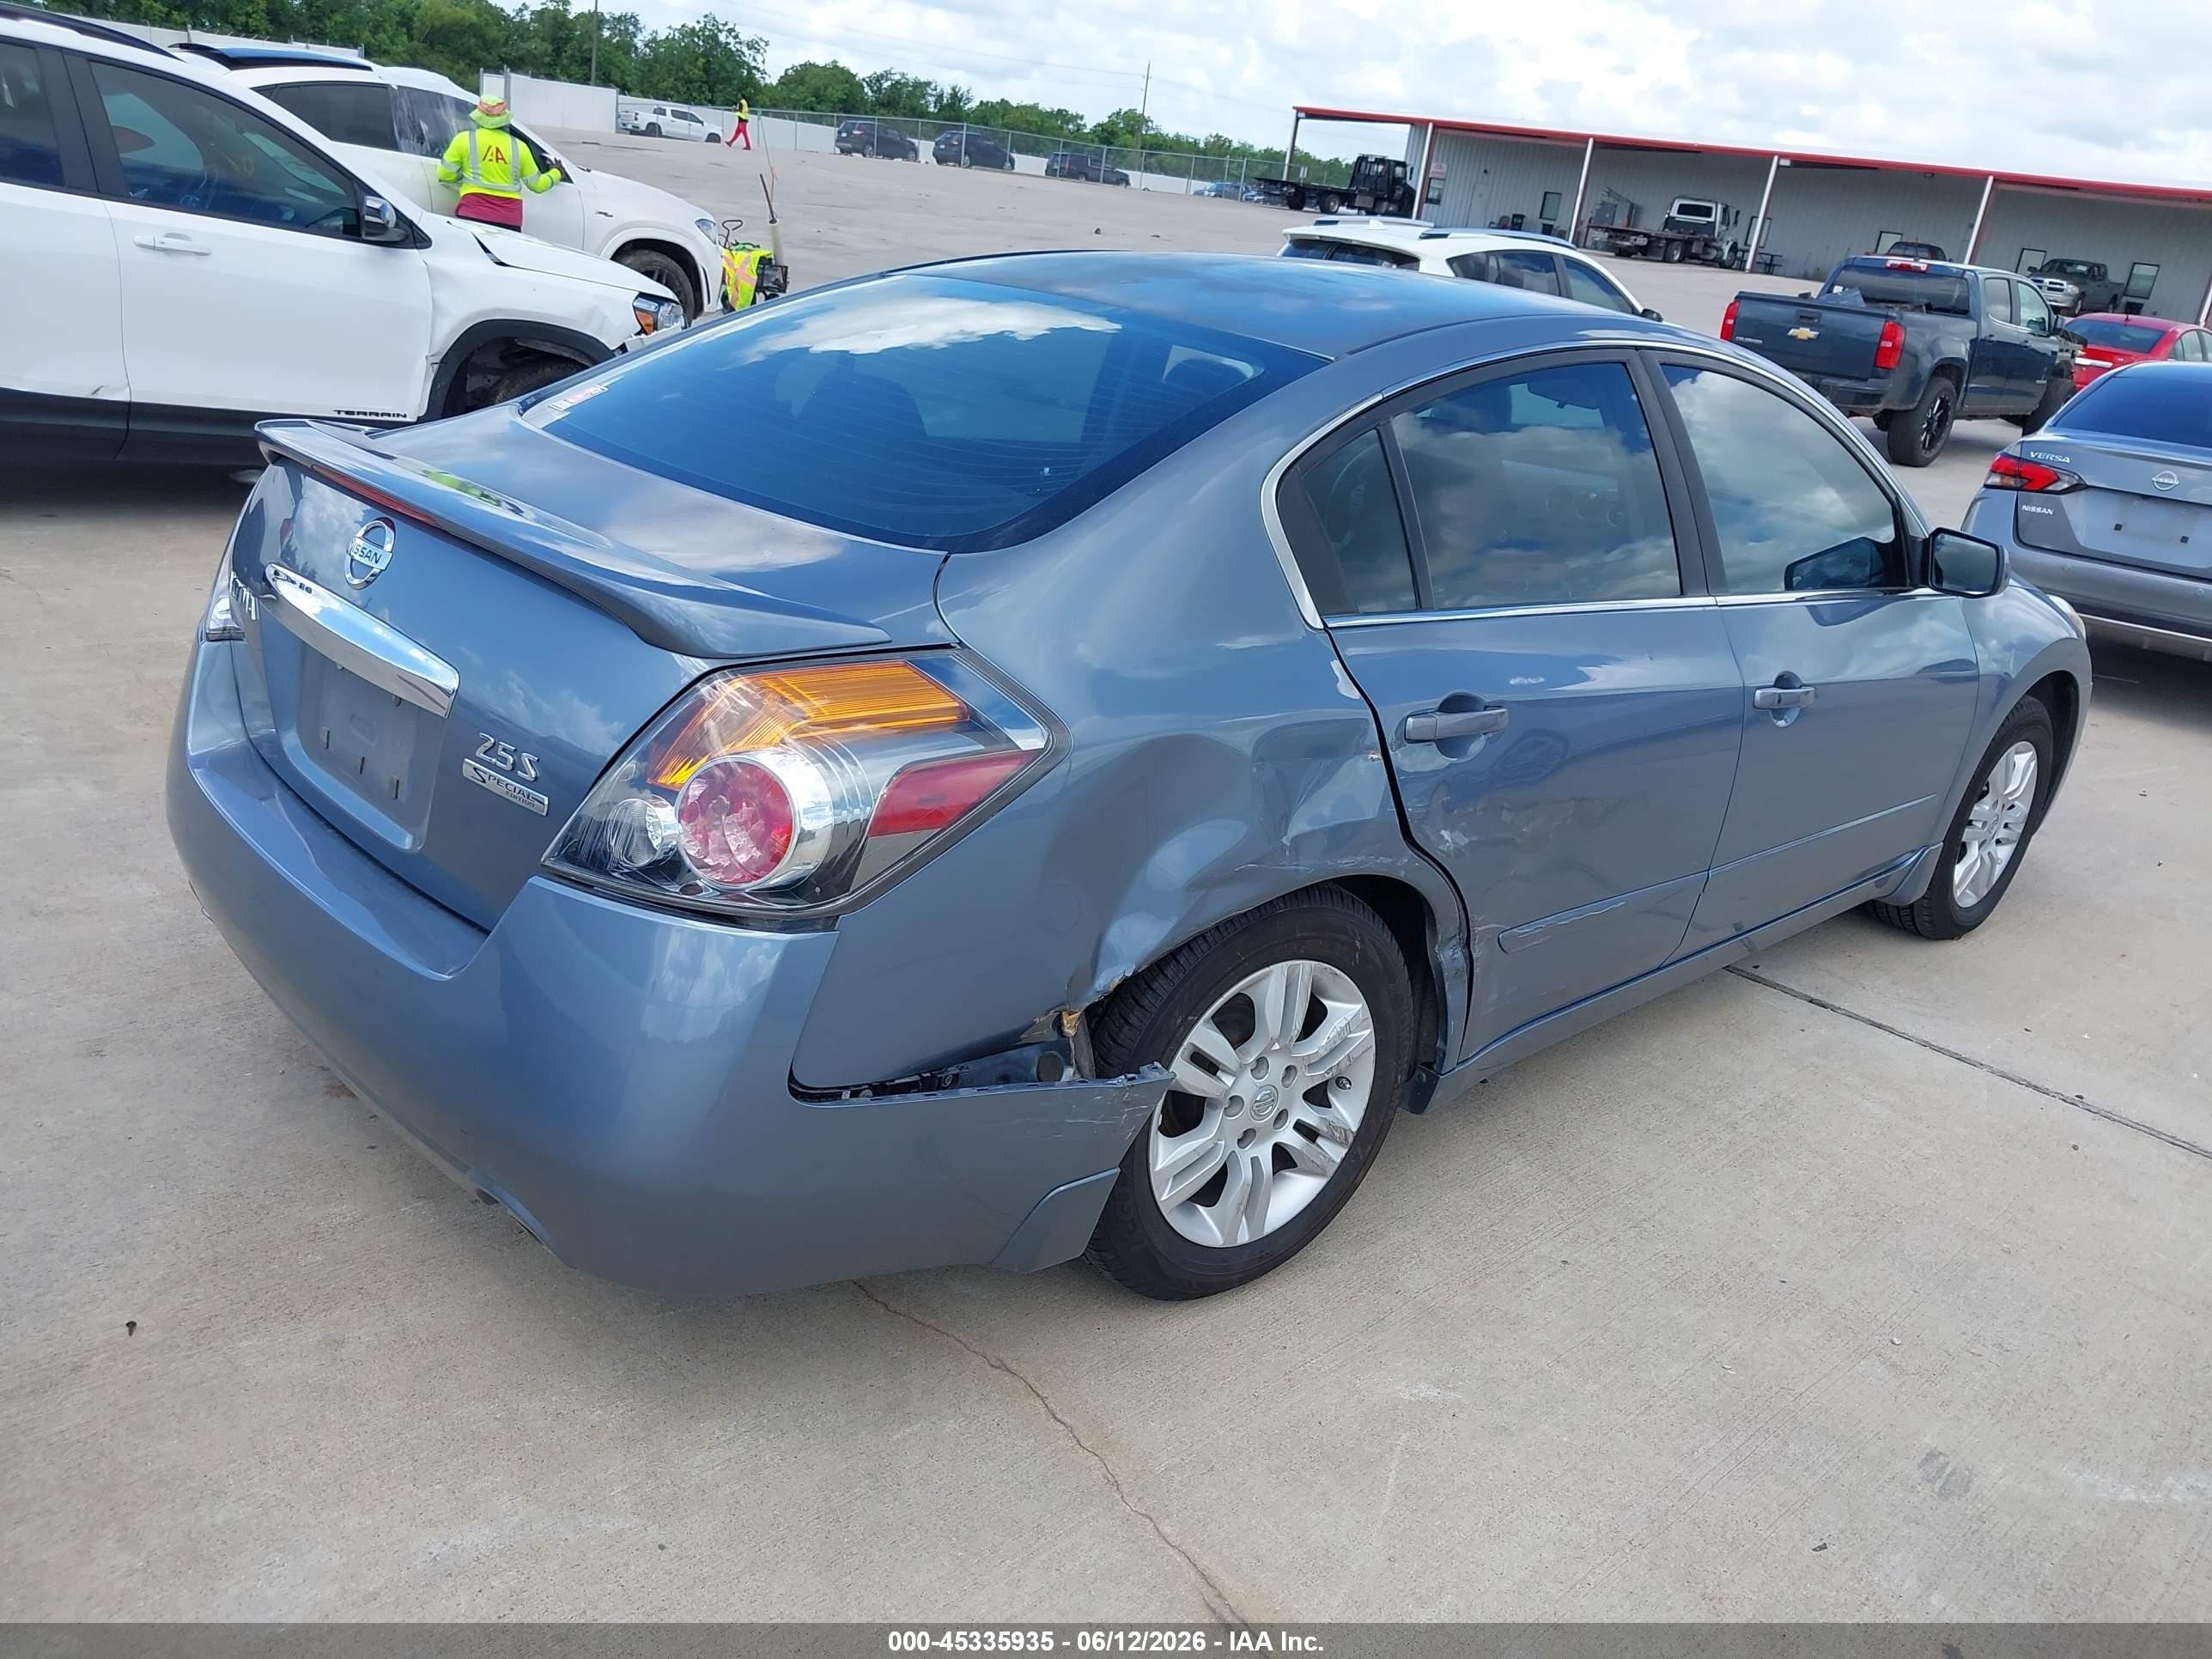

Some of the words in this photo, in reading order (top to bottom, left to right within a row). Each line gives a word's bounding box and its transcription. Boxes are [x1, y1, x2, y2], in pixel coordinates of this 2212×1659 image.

[333, 410, 407, 419] TERRAIN
[2030, 451, 2070, 464] VERSA
[2021, 504, 2054, 515] NISSAN
[517, 752, 540, 781] S
[471, 767, 544, 805] SPECIAL
[506, 791, 535, 808] EDITION
